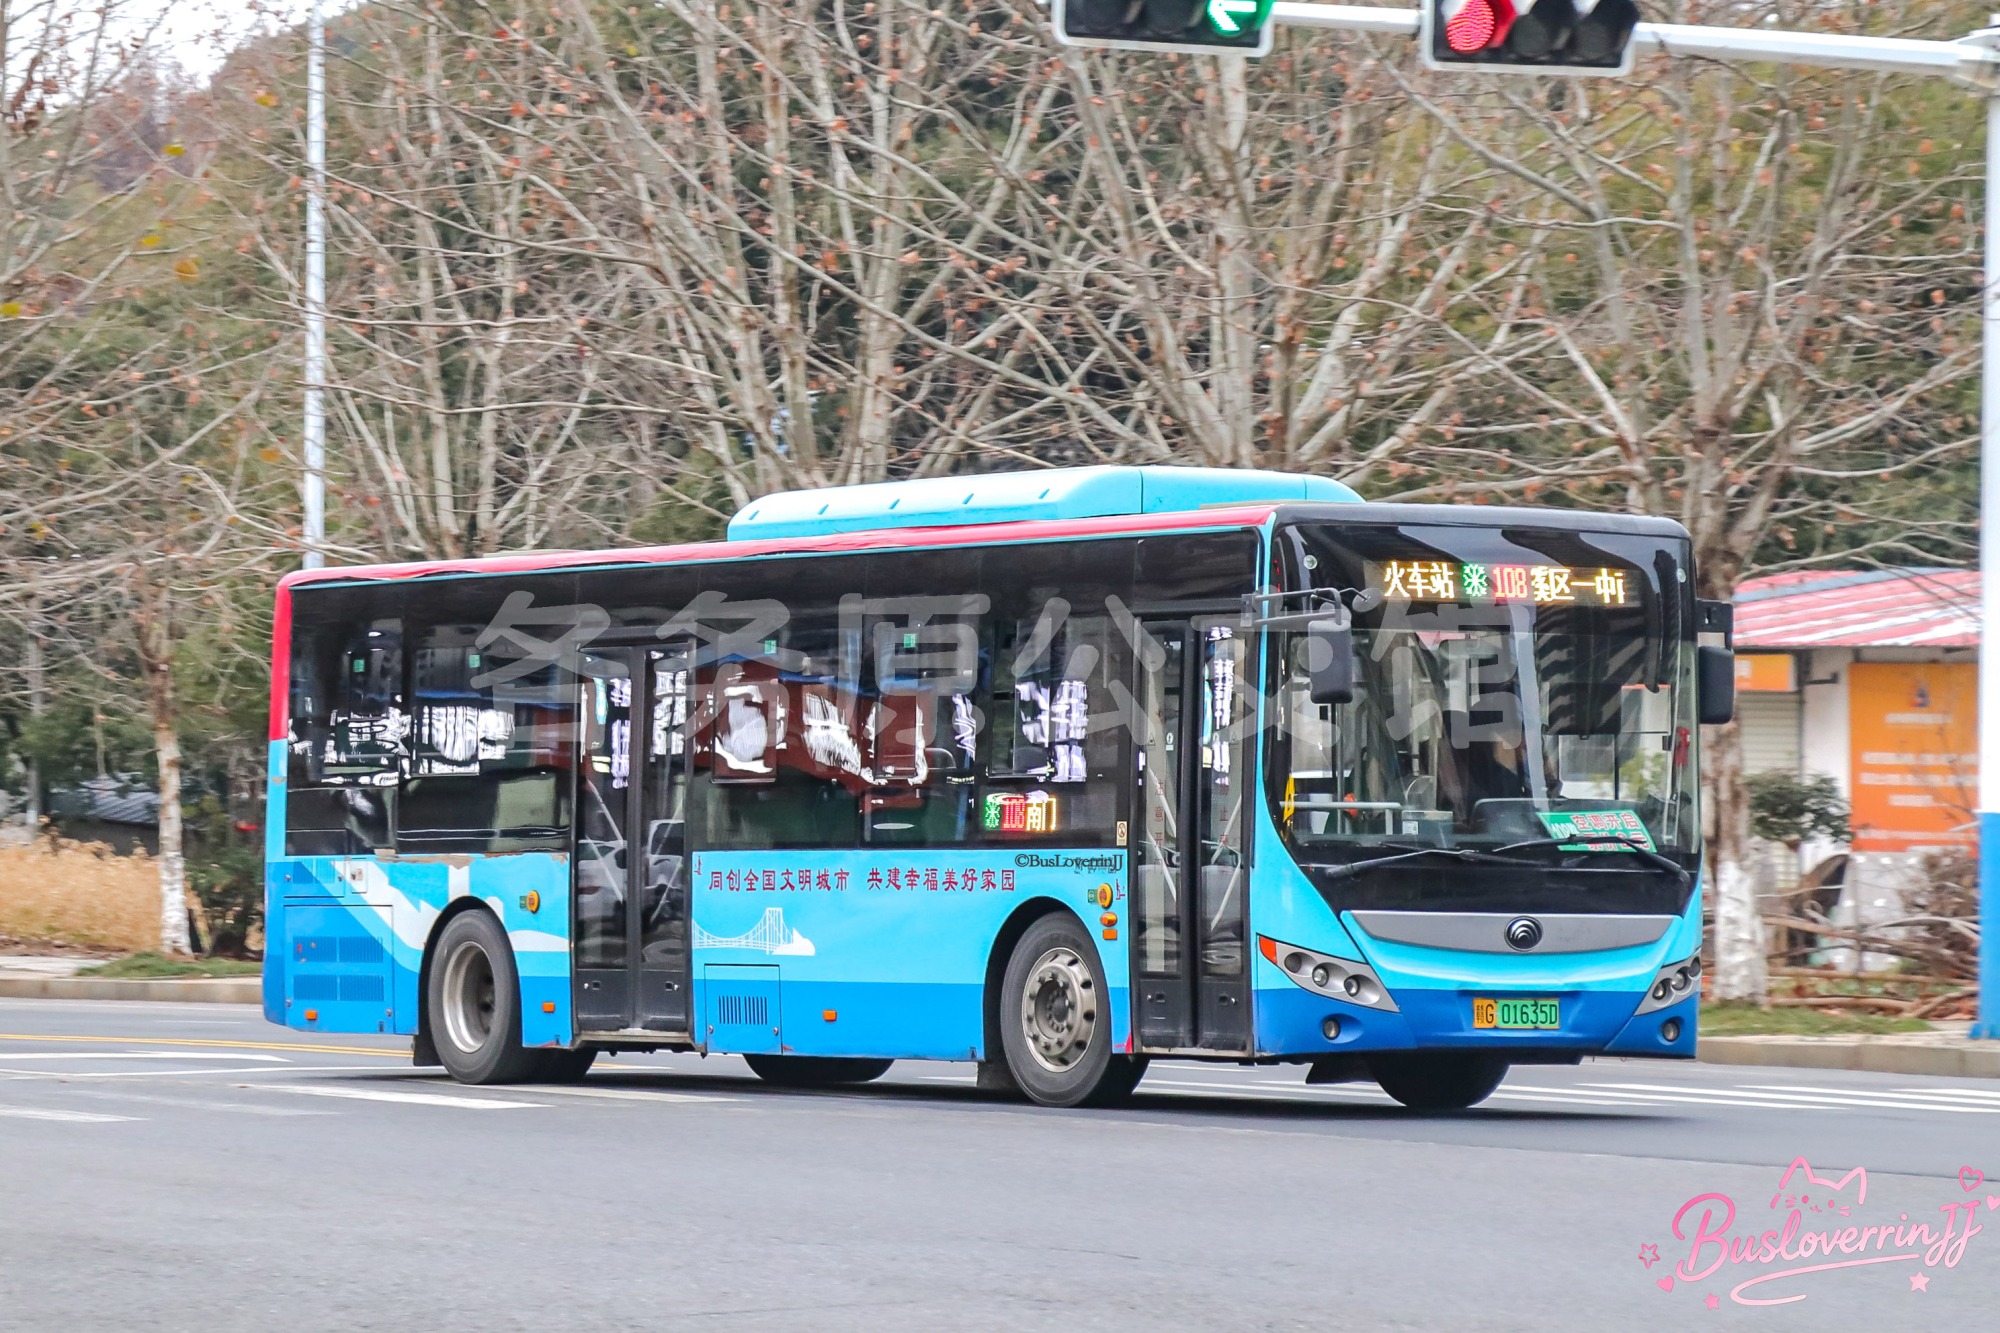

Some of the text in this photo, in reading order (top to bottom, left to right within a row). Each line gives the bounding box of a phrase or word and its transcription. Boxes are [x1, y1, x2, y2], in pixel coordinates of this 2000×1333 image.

[1384, 561, 1455, 599] 火车站
[1493, 566, 1528, 599] 108
[1570, 812, 1641, 831] 空调开启
[708, 867, 1015, 892] 同创全国文明城市 共建幸福美好家园
